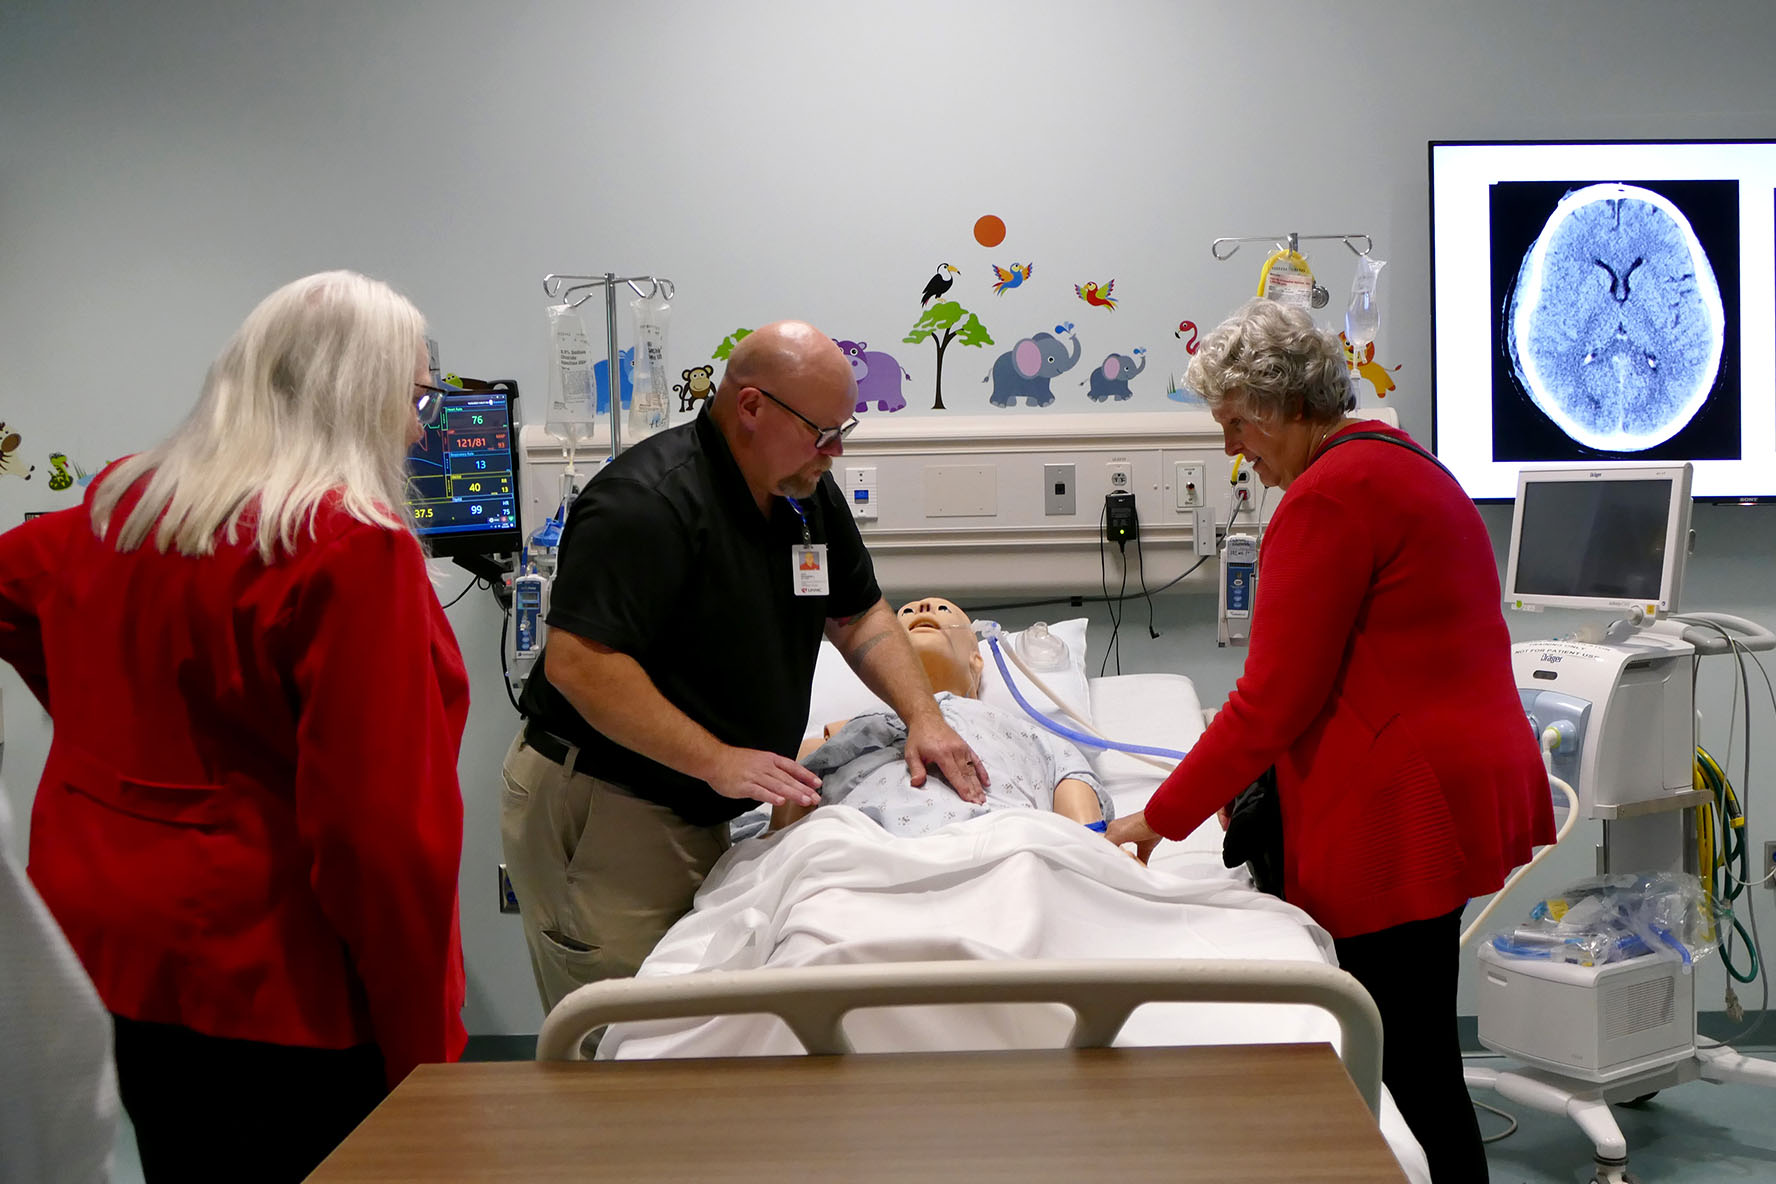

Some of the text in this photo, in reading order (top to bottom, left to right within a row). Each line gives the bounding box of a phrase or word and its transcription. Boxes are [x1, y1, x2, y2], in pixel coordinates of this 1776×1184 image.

[471, 415, 484, 425] 76
[456, 438, 486, 448] 121/81
[475, 460, 487, 469] 13
[469, 482, 481, 492] 40
[414, 508, 434, 518] 37.5
[470, 505, 483, 515] 99
[1540, 653, 1563, 664] Dräger
